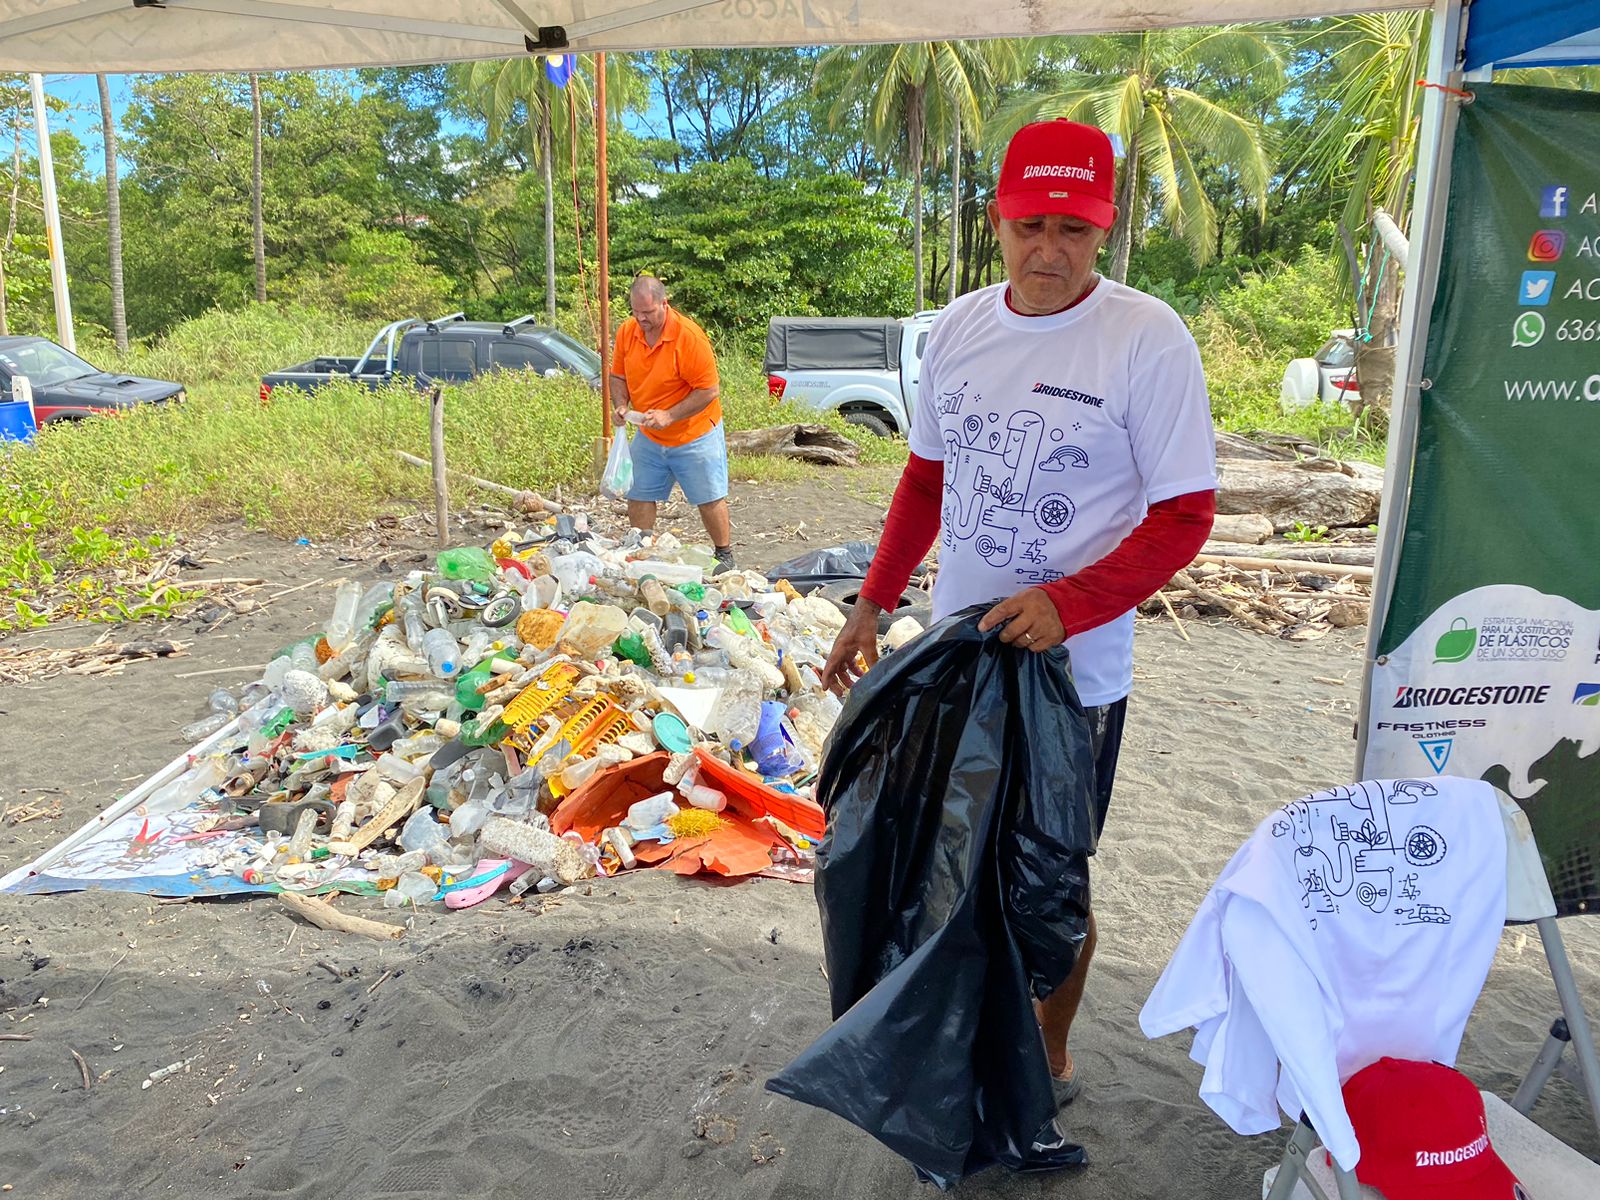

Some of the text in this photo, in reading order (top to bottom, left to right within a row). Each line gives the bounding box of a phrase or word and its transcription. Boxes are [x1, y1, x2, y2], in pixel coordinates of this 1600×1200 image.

[1023, 165, 1096, 182] BRIDGESTONE
[1031, 382, 1104, 408] BRIDGESTONE
[1483, 617, 1574, 628] ESTRATEGIA NACIONAL
[1481, 625, 1501, 633] PARA
[1503, 626, 1513, 634] LA
[1479, 635, 1495, 647] DE
[1477, 648, 1568, 659] DE UN SOLO USO
[1392, 685, 1551, 709] BRIDGESTONE
[1377, 719, 1487, 732] FASTNESS
[1412, 731, 1456, 739] CLOTHING
